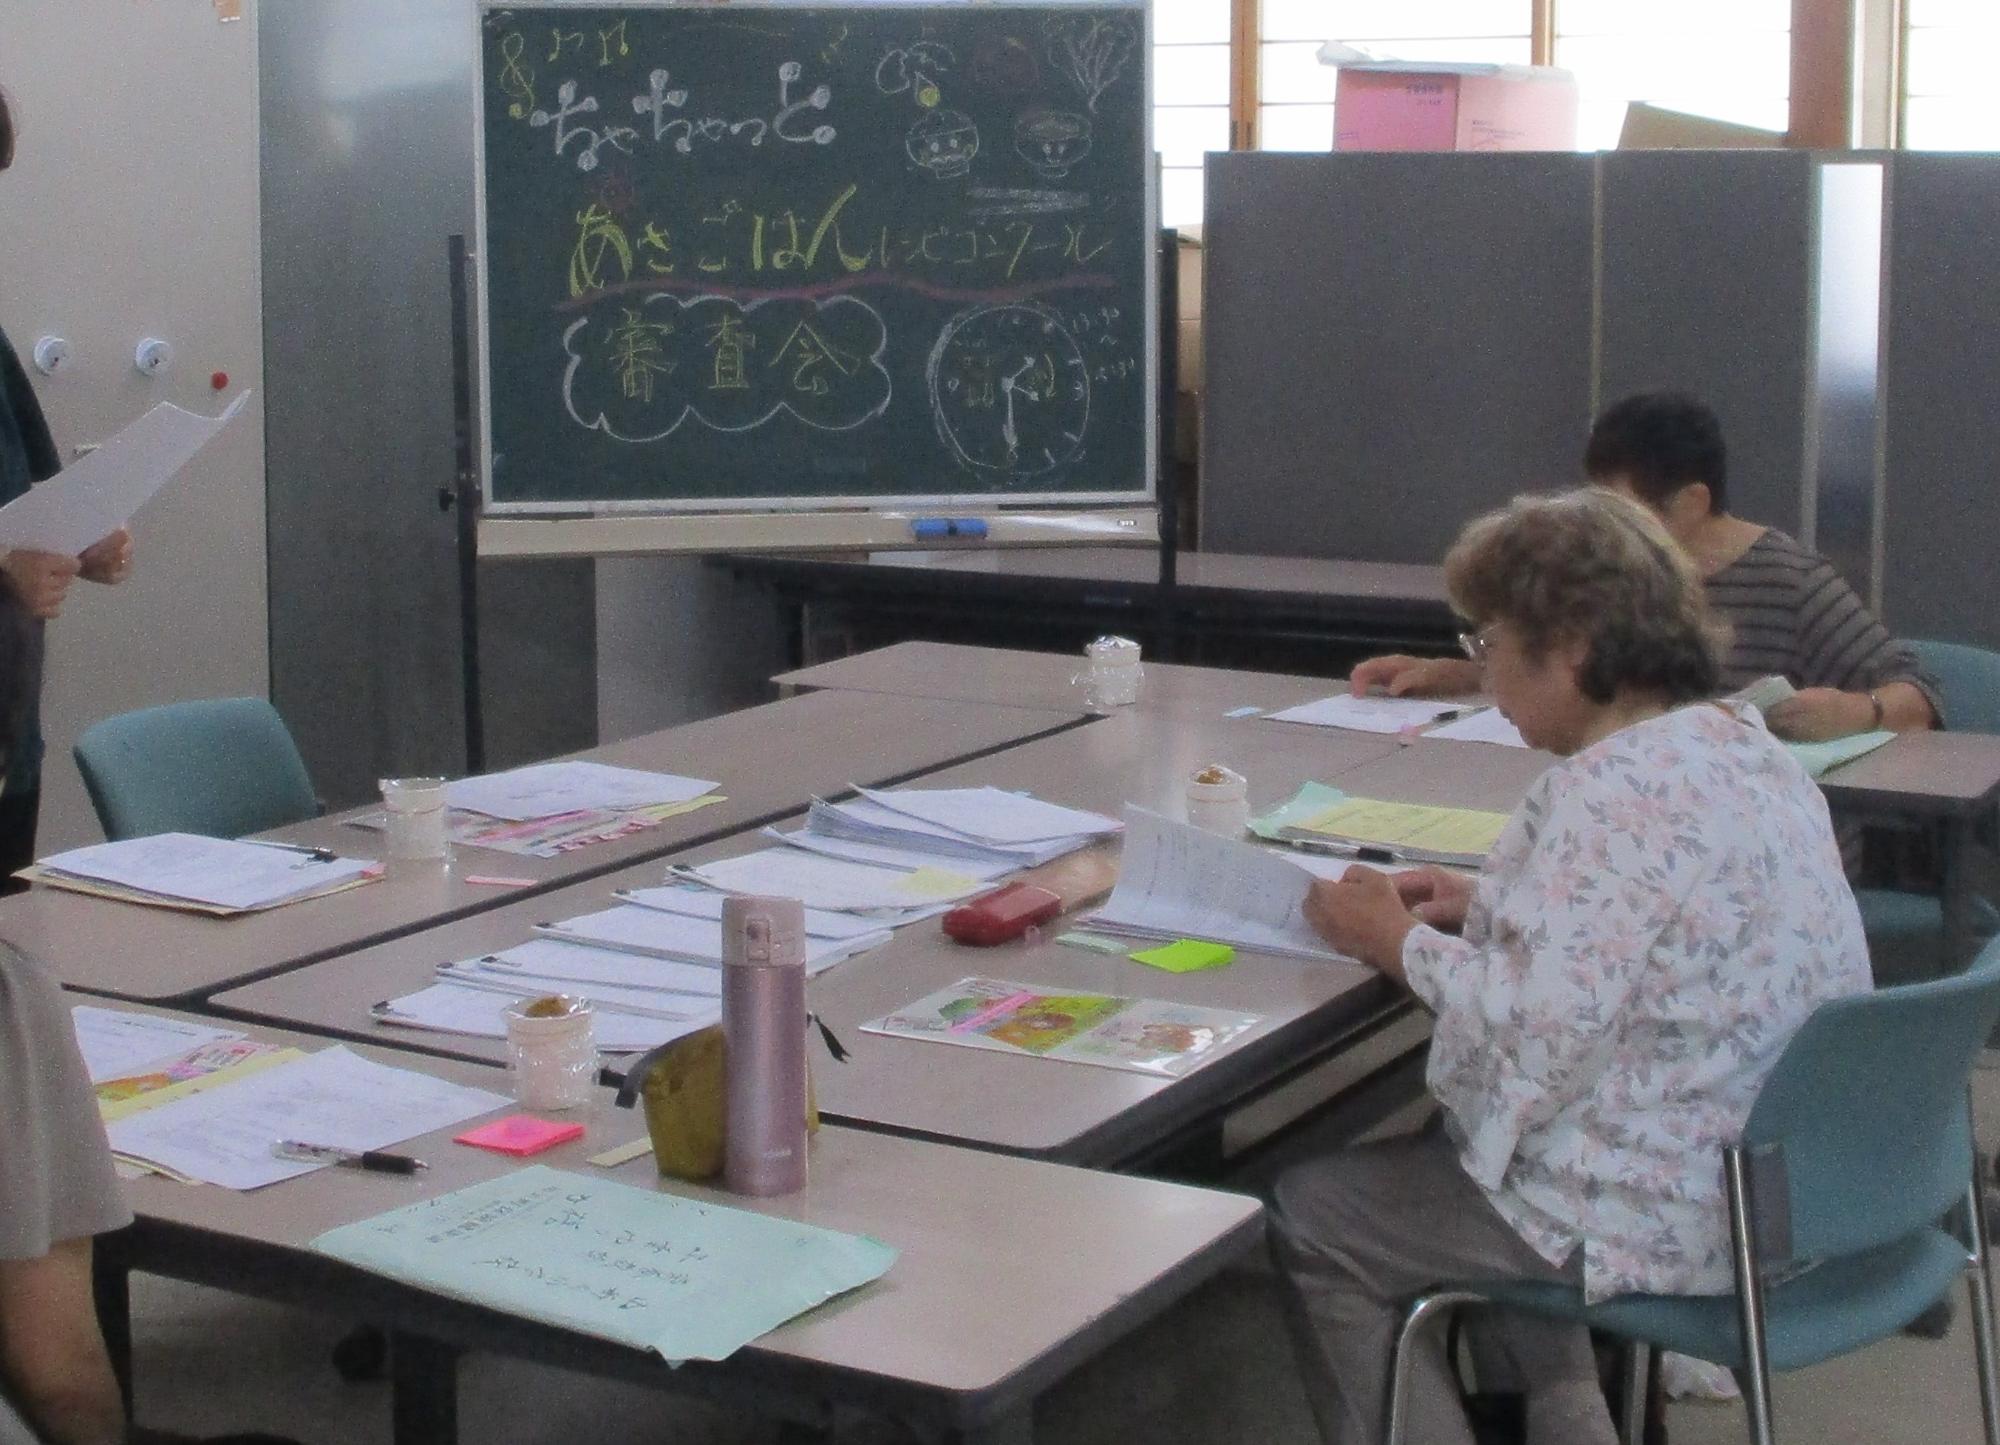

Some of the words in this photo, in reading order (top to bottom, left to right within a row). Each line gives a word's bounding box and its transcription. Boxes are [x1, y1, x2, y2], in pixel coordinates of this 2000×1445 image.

[530, 61, 837, 171] ちゃちゃっと
[604, 307, 862, 402] 審査会
